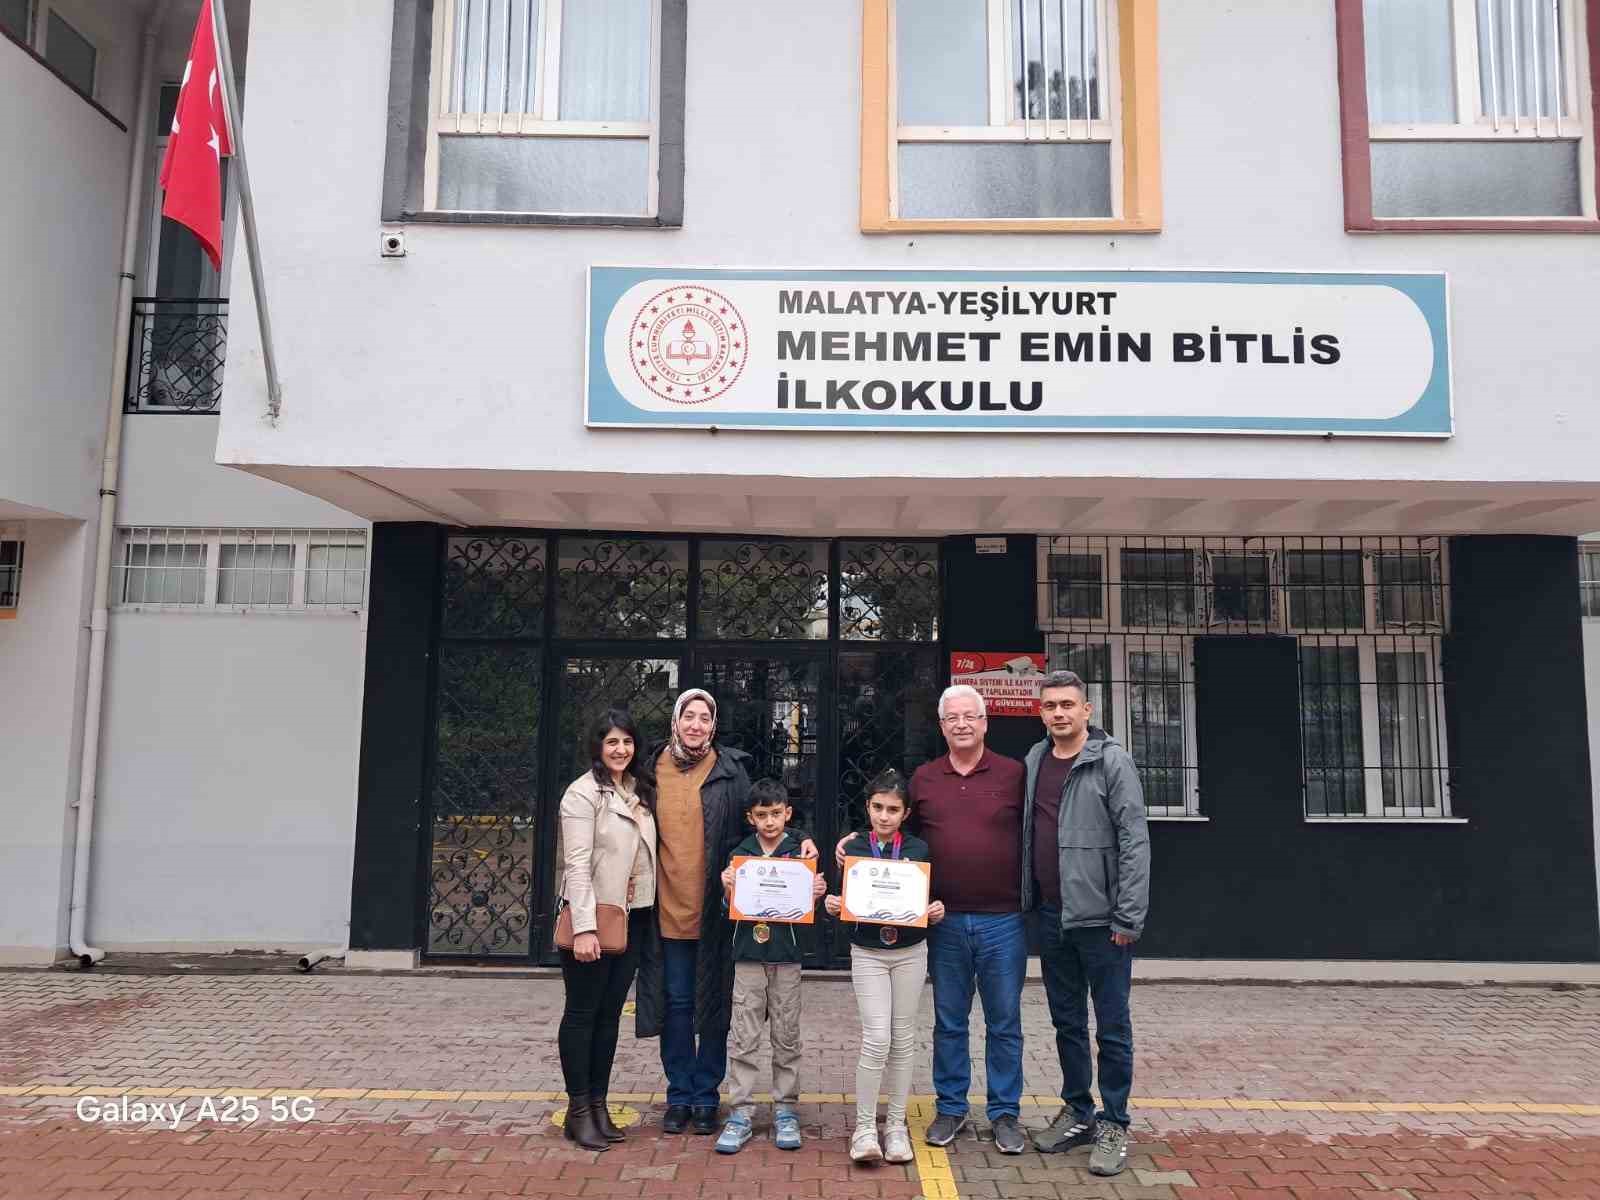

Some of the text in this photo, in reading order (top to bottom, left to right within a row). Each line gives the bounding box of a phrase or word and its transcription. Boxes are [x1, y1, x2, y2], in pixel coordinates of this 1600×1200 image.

[779, 286, 1118, 322] MALATYA-YEŞİLYURT
[777, 325, 1341, 365] MEHMET EMİN BİTLİS
[777, 371, 1043, 412] İLKOKULU
